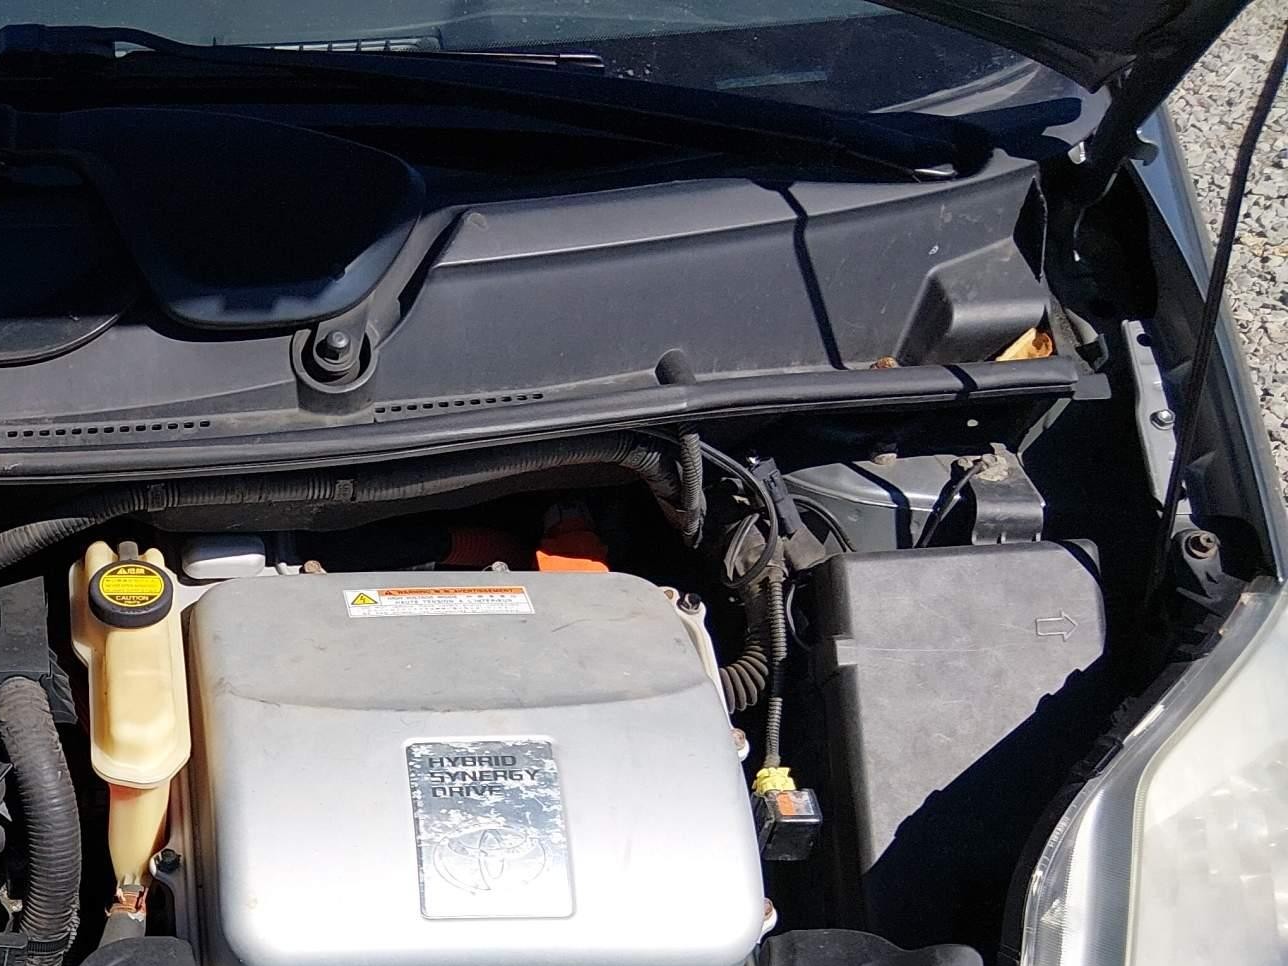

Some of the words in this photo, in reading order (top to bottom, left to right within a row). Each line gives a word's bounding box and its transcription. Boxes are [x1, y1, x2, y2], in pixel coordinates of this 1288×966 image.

[428, 755, 517, 768] HYBRID
[430, 770, 539, 783] SYNERGY
[431, 785, 505, 797] DRIVE
